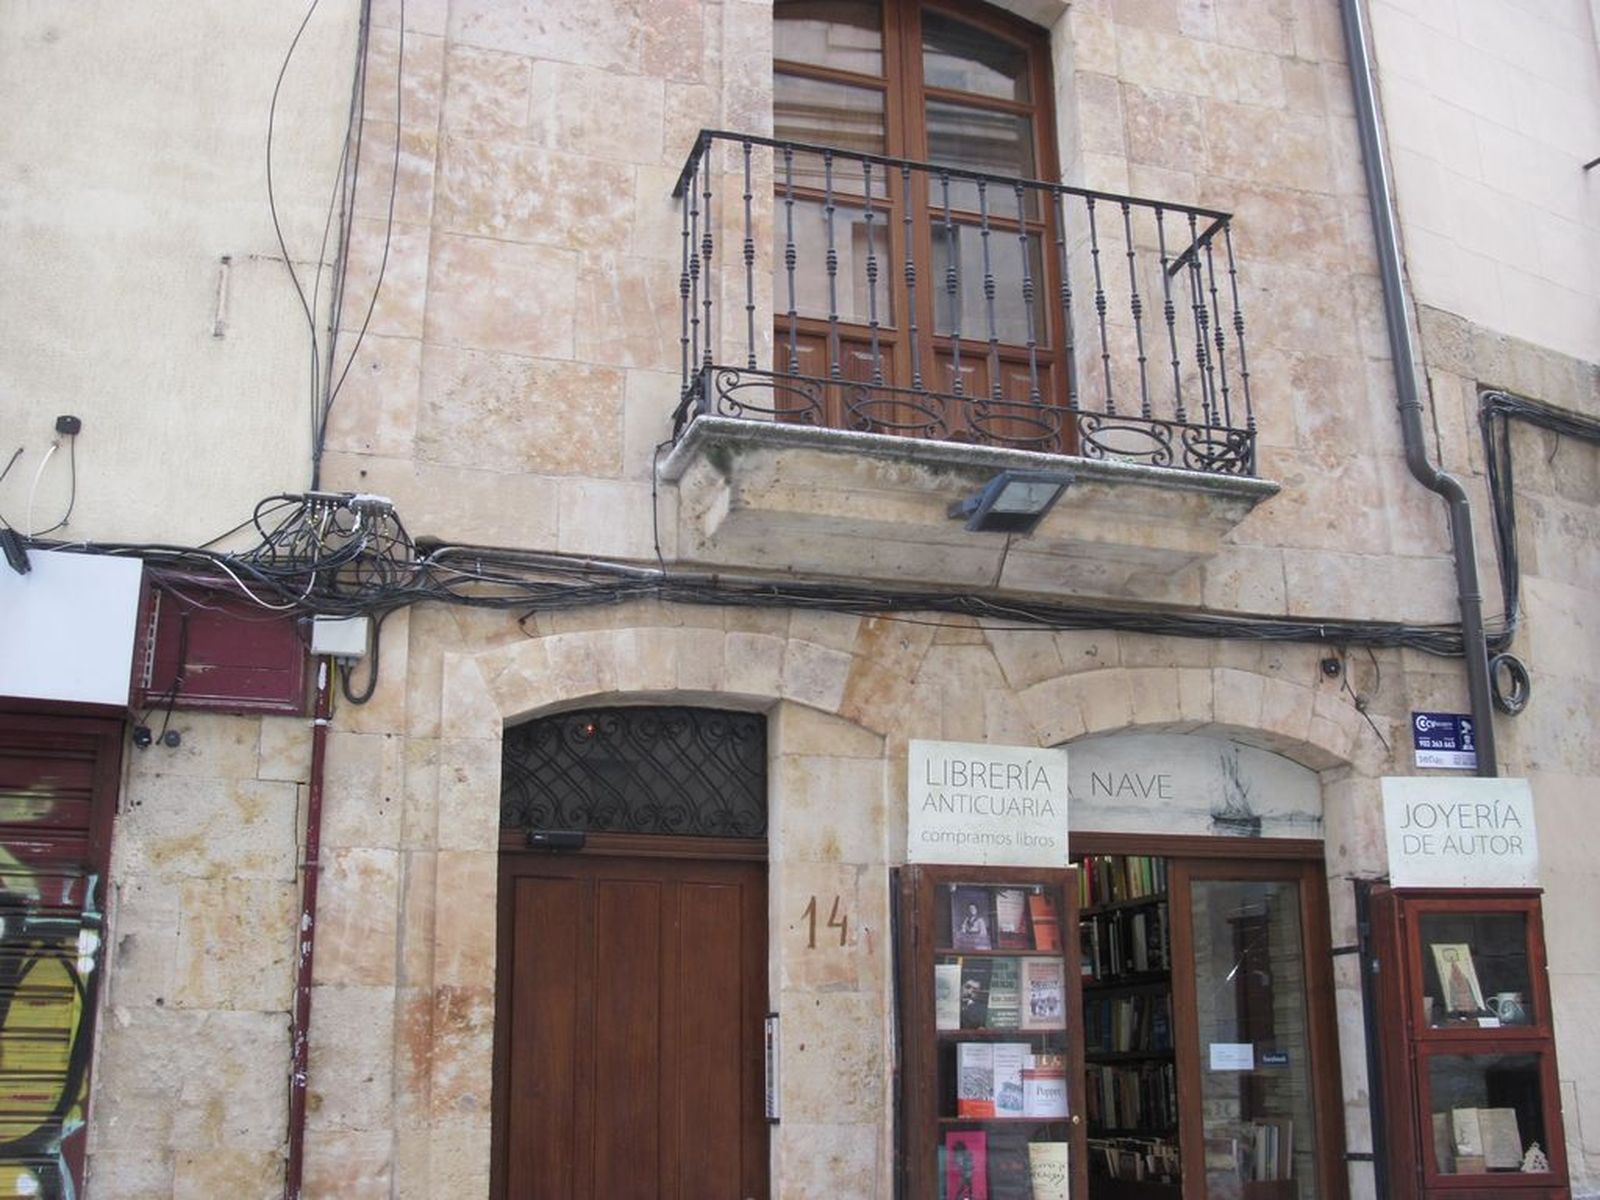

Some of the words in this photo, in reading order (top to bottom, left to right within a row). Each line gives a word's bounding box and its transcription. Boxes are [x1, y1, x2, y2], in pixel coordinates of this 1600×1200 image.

[926, 757, 1051, 791] LIBRERÍA
[1091, 771, 1173, 799] NAVE
[922, 791, 1055, 817] ANTICUARIA
[1400, 799, 1522, 829] JOYERÍA
[921, 830, 1012, 846] compramos
[1016, 831, 1056, 848] libros
[1402, 834, 1435, 855] DE
[1442, 835, 1524, 856] AUTOR
[800, 895, 848, 950] 14
